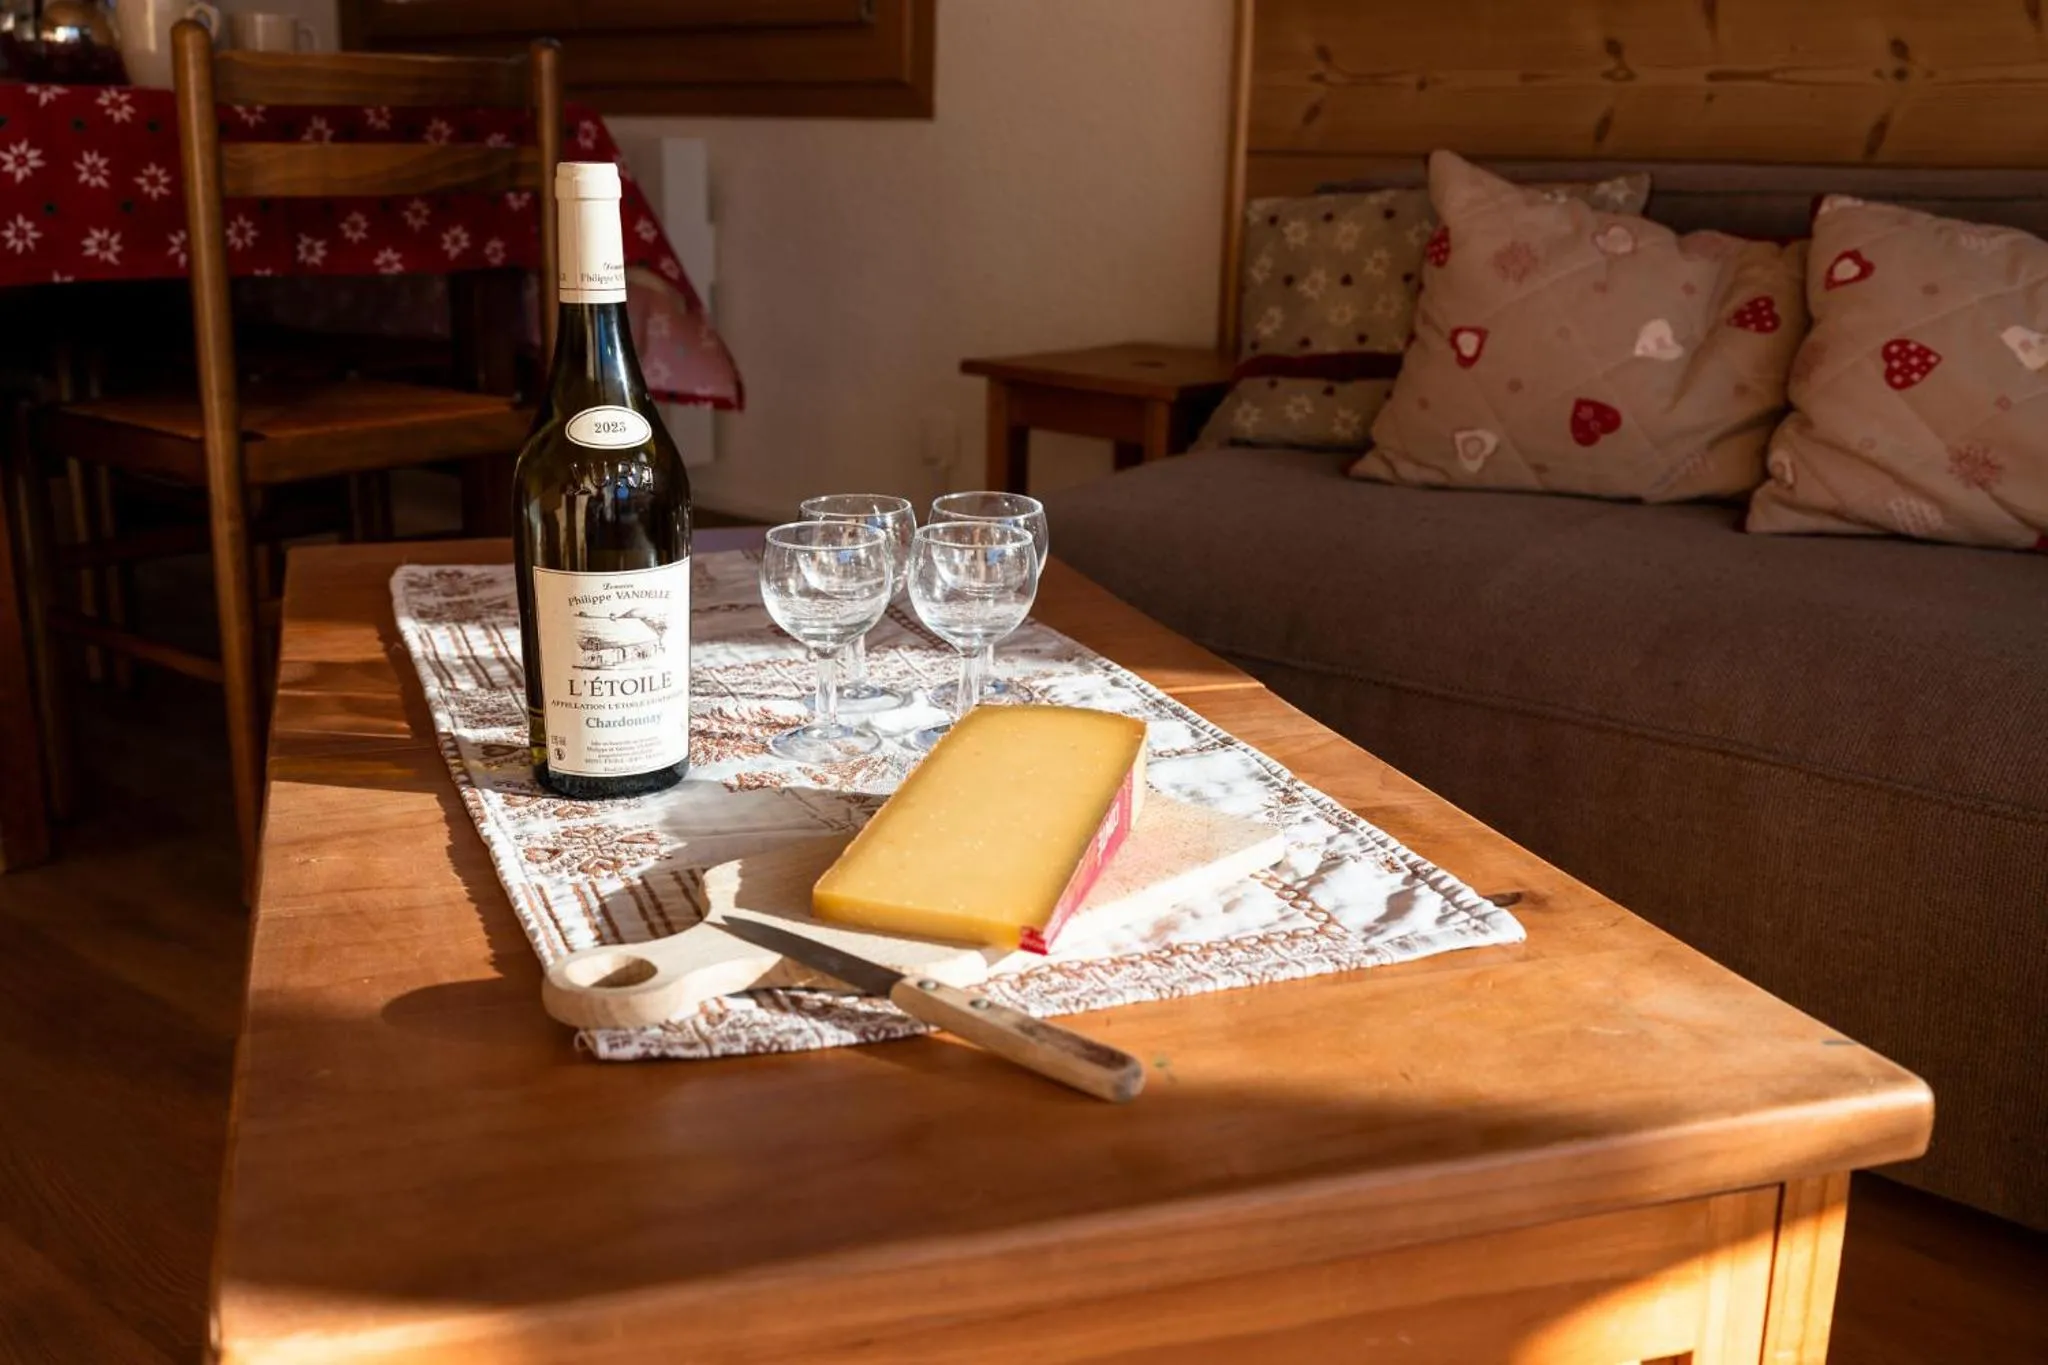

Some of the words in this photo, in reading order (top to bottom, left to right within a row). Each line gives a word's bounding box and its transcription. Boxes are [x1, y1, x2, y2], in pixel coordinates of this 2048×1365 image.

[594, 422, 627, 434] 2023
[568, 594, 612, 607] Philippe
[615, 590, 672, 600] VANDELLE
[568, 671, 672, 698] L'ÉTOILE
[551, 699, 605, 711] APPELLATION
[585, 713, 662, 729] Chardonnay
